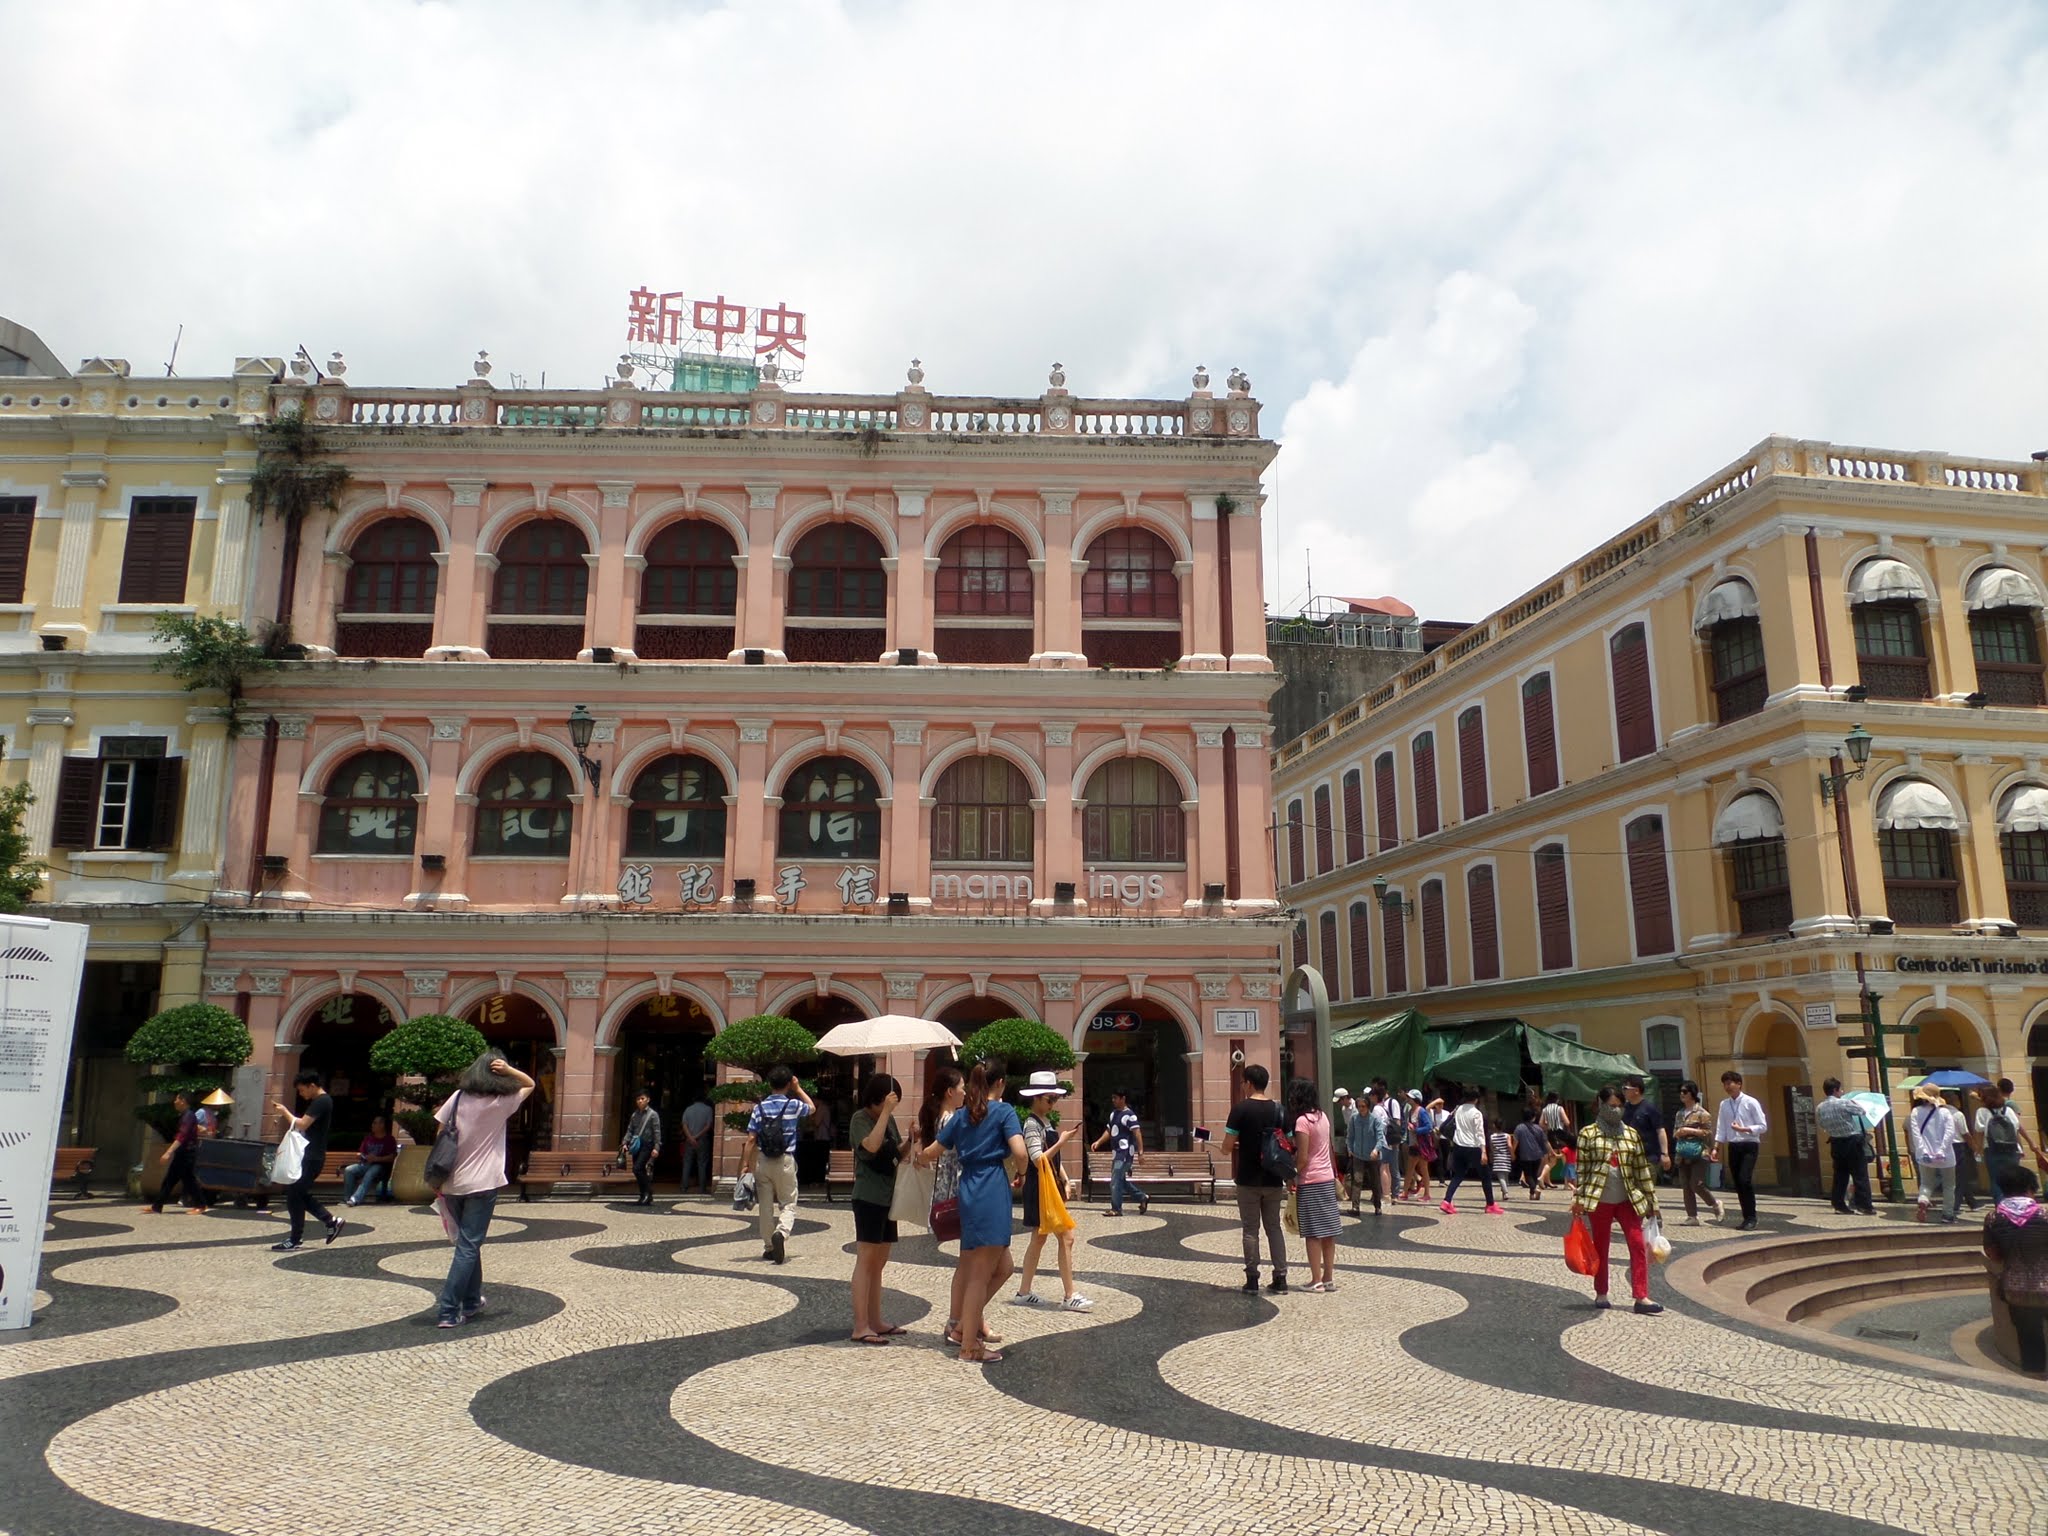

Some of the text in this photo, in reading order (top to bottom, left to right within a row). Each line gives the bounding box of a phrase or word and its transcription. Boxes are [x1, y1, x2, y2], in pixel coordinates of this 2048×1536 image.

[627, 286, 807, 360] 新中央
[617, 864, 877, 906] 鉅記手信
[1897, 957, 1947, 972] Centro
[1950, 957, 1969, 973] de
[1970, 958, 2036, 974] Turismo
